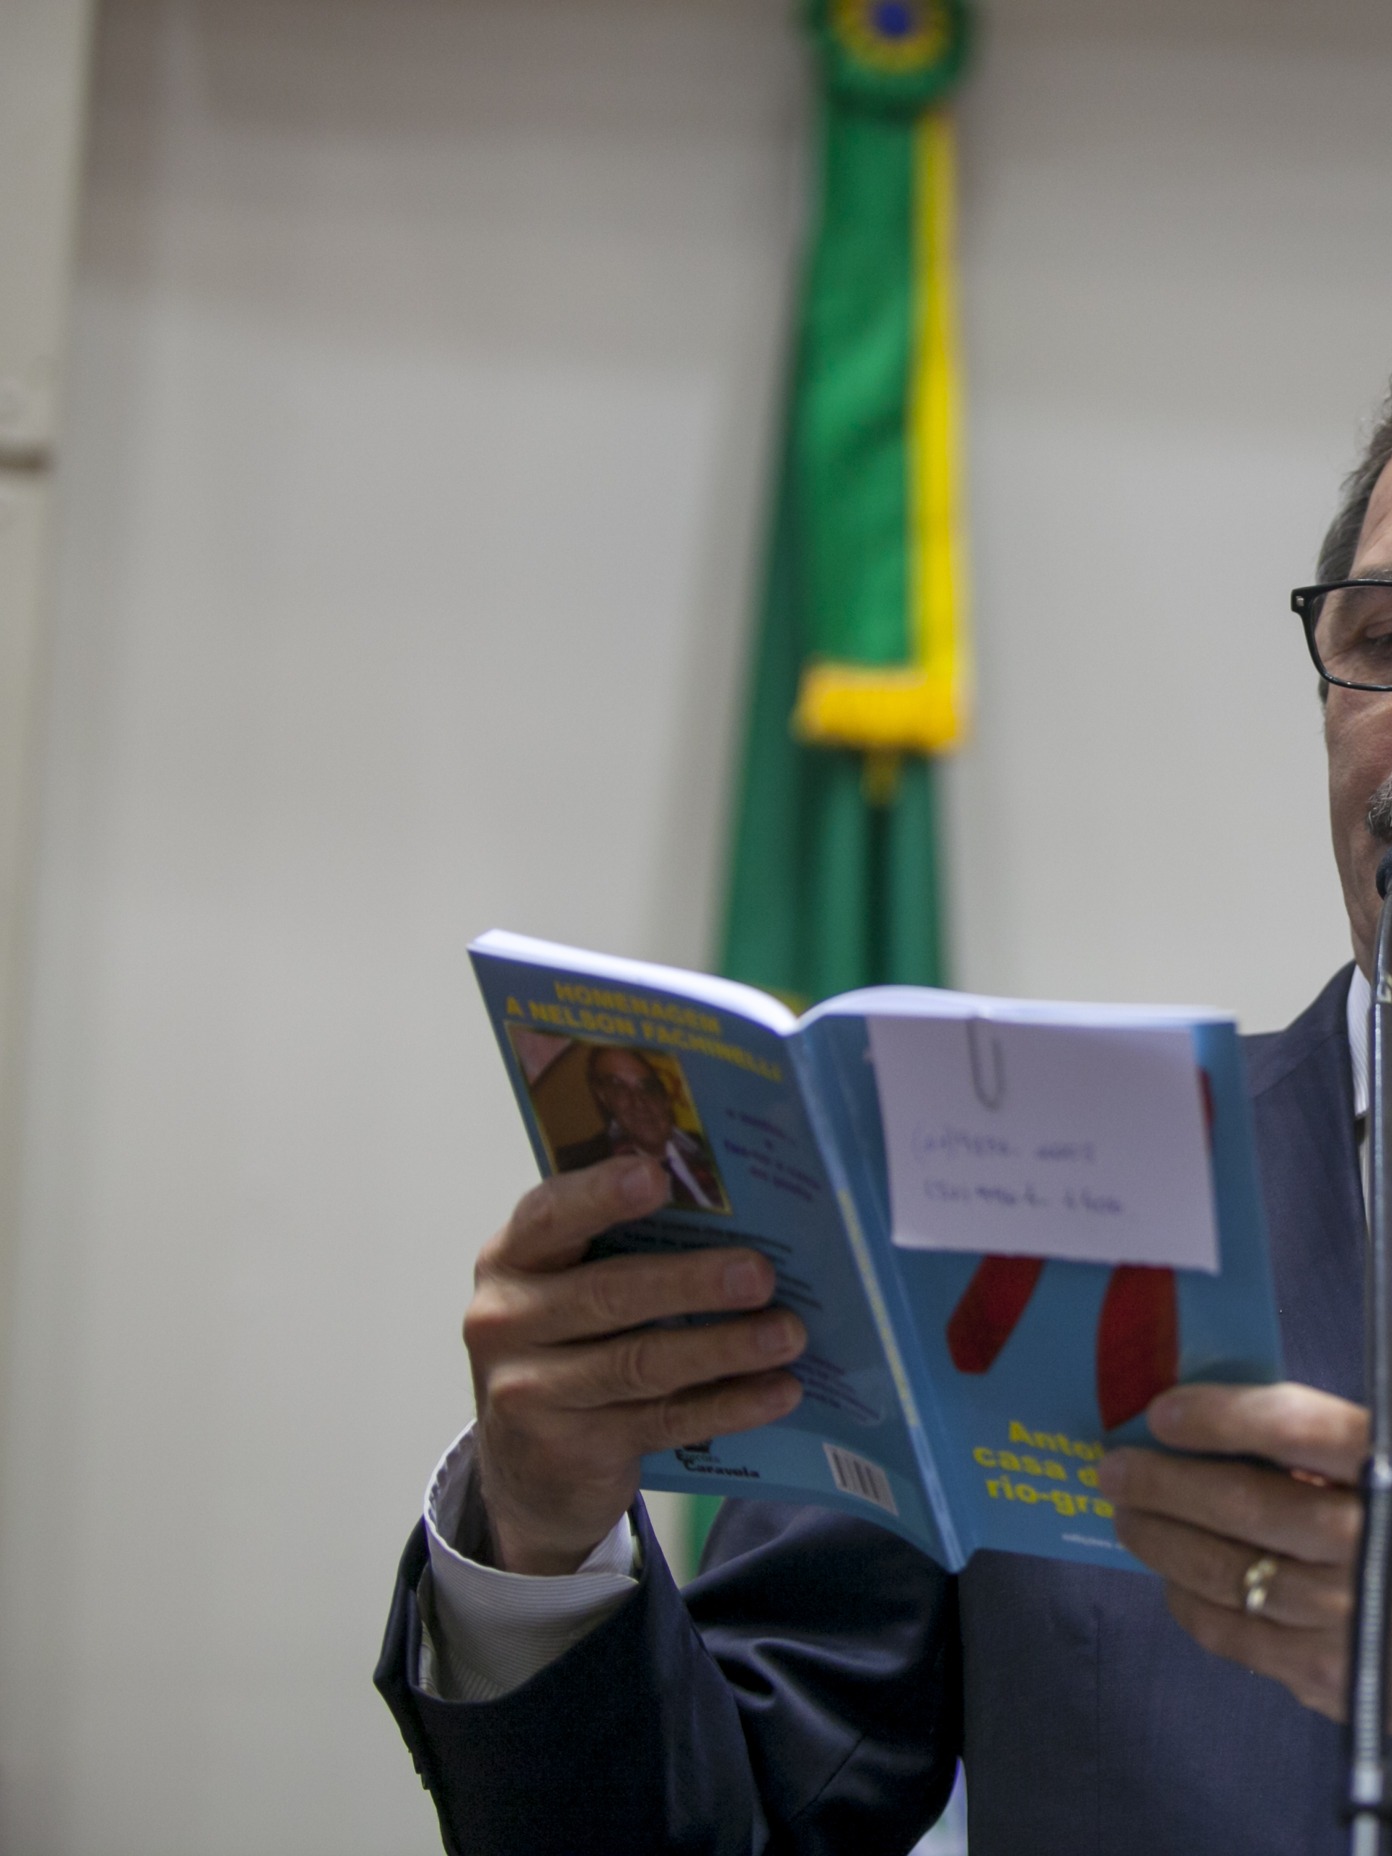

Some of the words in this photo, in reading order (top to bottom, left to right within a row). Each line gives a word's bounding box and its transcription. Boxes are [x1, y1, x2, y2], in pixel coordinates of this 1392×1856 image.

[506, 996, 523, 1018] A
[528, 1000, 636, 1037] NELSON
[554, 981, 721, 1034] HOMENAGEM
[972, 1446, 1068, 1481] casa
